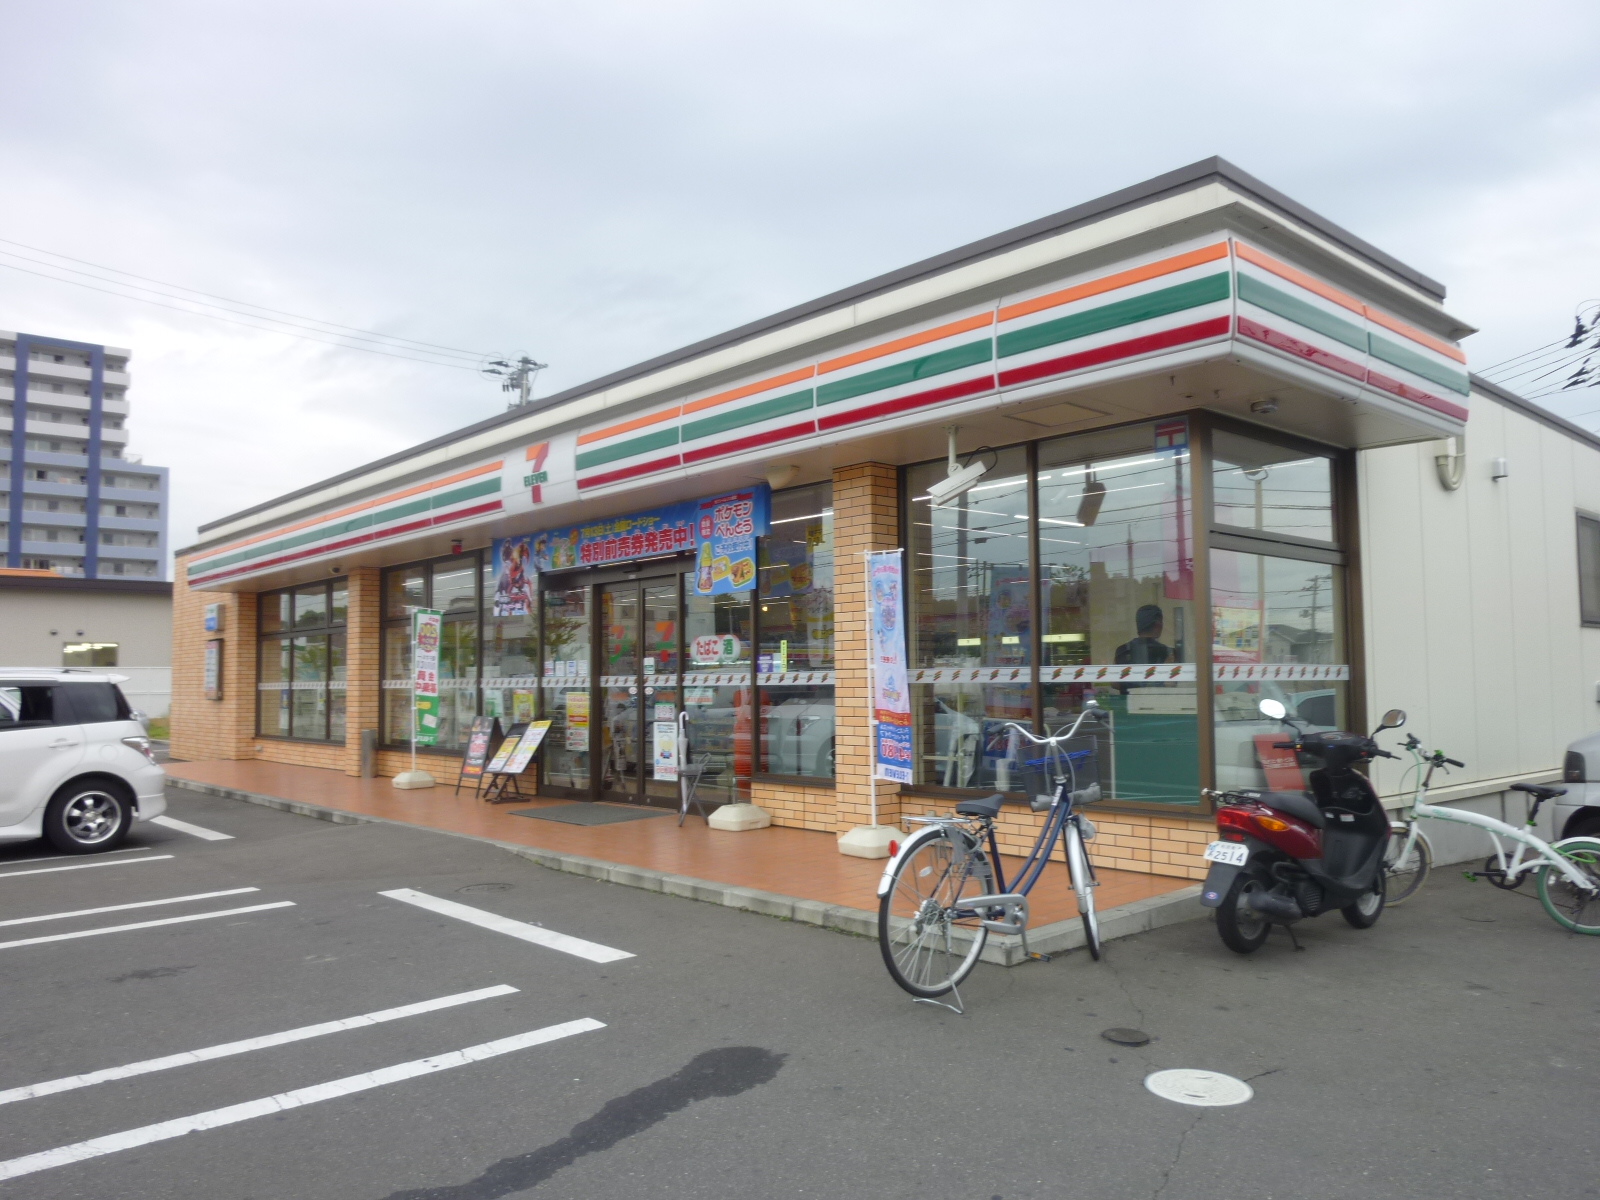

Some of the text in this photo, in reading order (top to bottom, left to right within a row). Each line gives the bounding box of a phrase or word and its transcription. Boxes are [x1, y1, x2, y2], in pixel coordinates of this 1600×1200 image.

[714, 502, 752, 522] ポケモン
[715, 518, 753, 538] べんとう
[696, 640, 718, 655] たばこ
[723, 639, 733, 655] 酒
[1214, 850, 1244, 863] 2514
